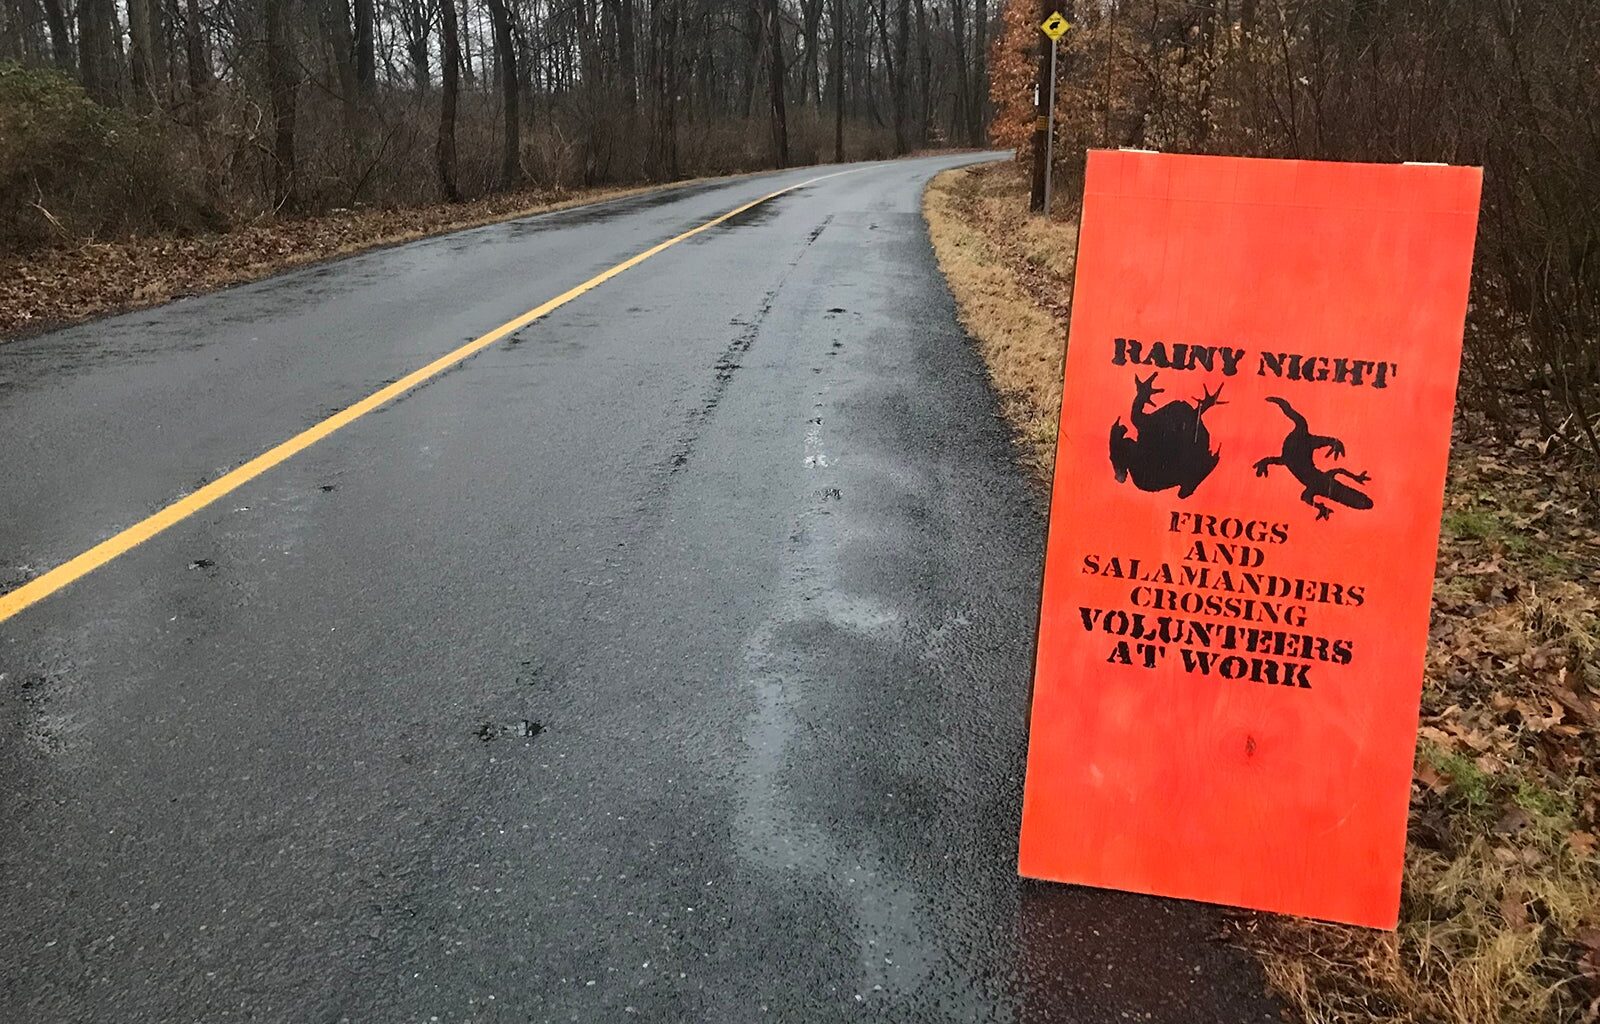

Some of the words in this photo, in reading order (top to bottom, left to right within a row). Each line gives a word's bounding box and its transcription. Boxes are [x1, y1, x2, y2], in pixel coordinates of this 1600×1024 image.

[1111, 337, 1246, 377] RAINY
[1257, 351, 1398, 389] NIGHT
[1168, 511, 1289, 545] FROGS
[1184, 540, 1265, 568] AND
[1081, 554, 1366, 607] SALAMANDERS
[1130, 586, 1307, 627] CROSSING
[1078, 606, 1354, 666] VOLUNTEERS
[1106, 640, 1166, 669] AT
[1180, 648, 1313, 689] WORK
